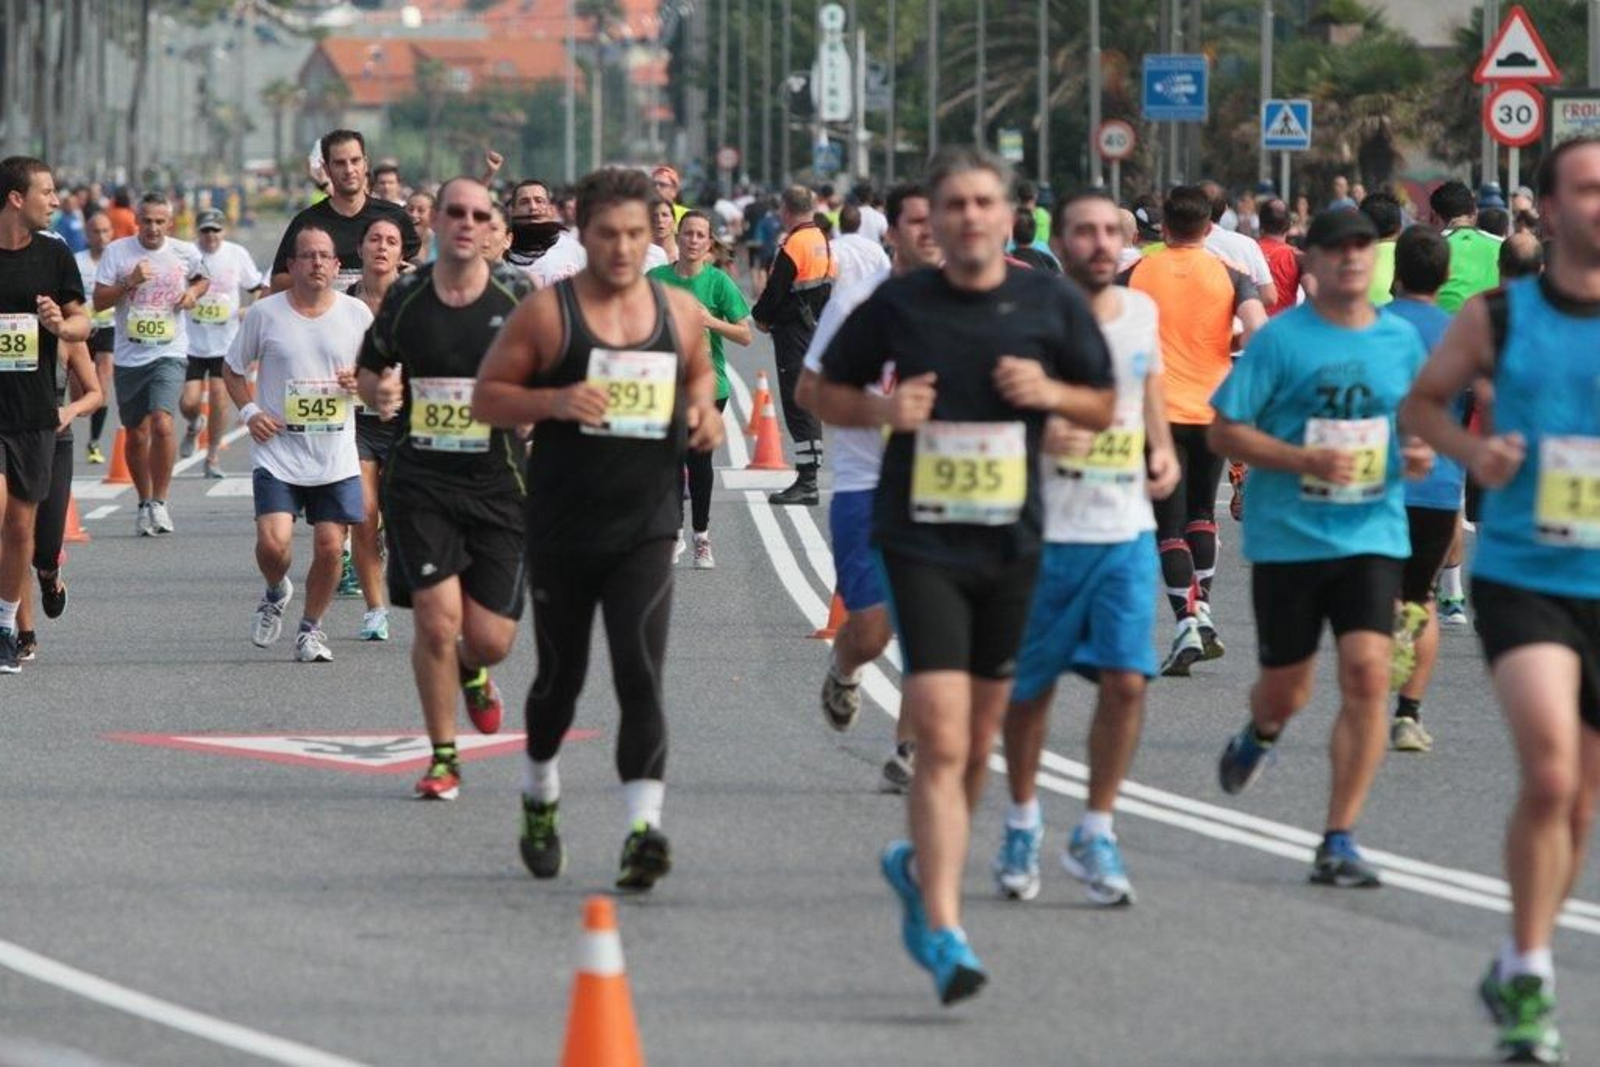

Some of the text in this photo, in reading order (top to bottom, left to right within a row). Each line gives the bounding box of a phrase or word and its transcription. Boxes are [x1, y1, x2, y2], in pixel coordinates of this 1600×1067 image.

[1499, 104, 1532, 124] 30
[197, 305, 220, 317] 241
[136, 321, 165, 335] 605
[0, 333, 27, 353] 38
[608, 381, 656, 410] 891
[297, 398, 337, 417] 545
[425, 403, 473, 429] 829
[935, 458, 1003, 494] 935
